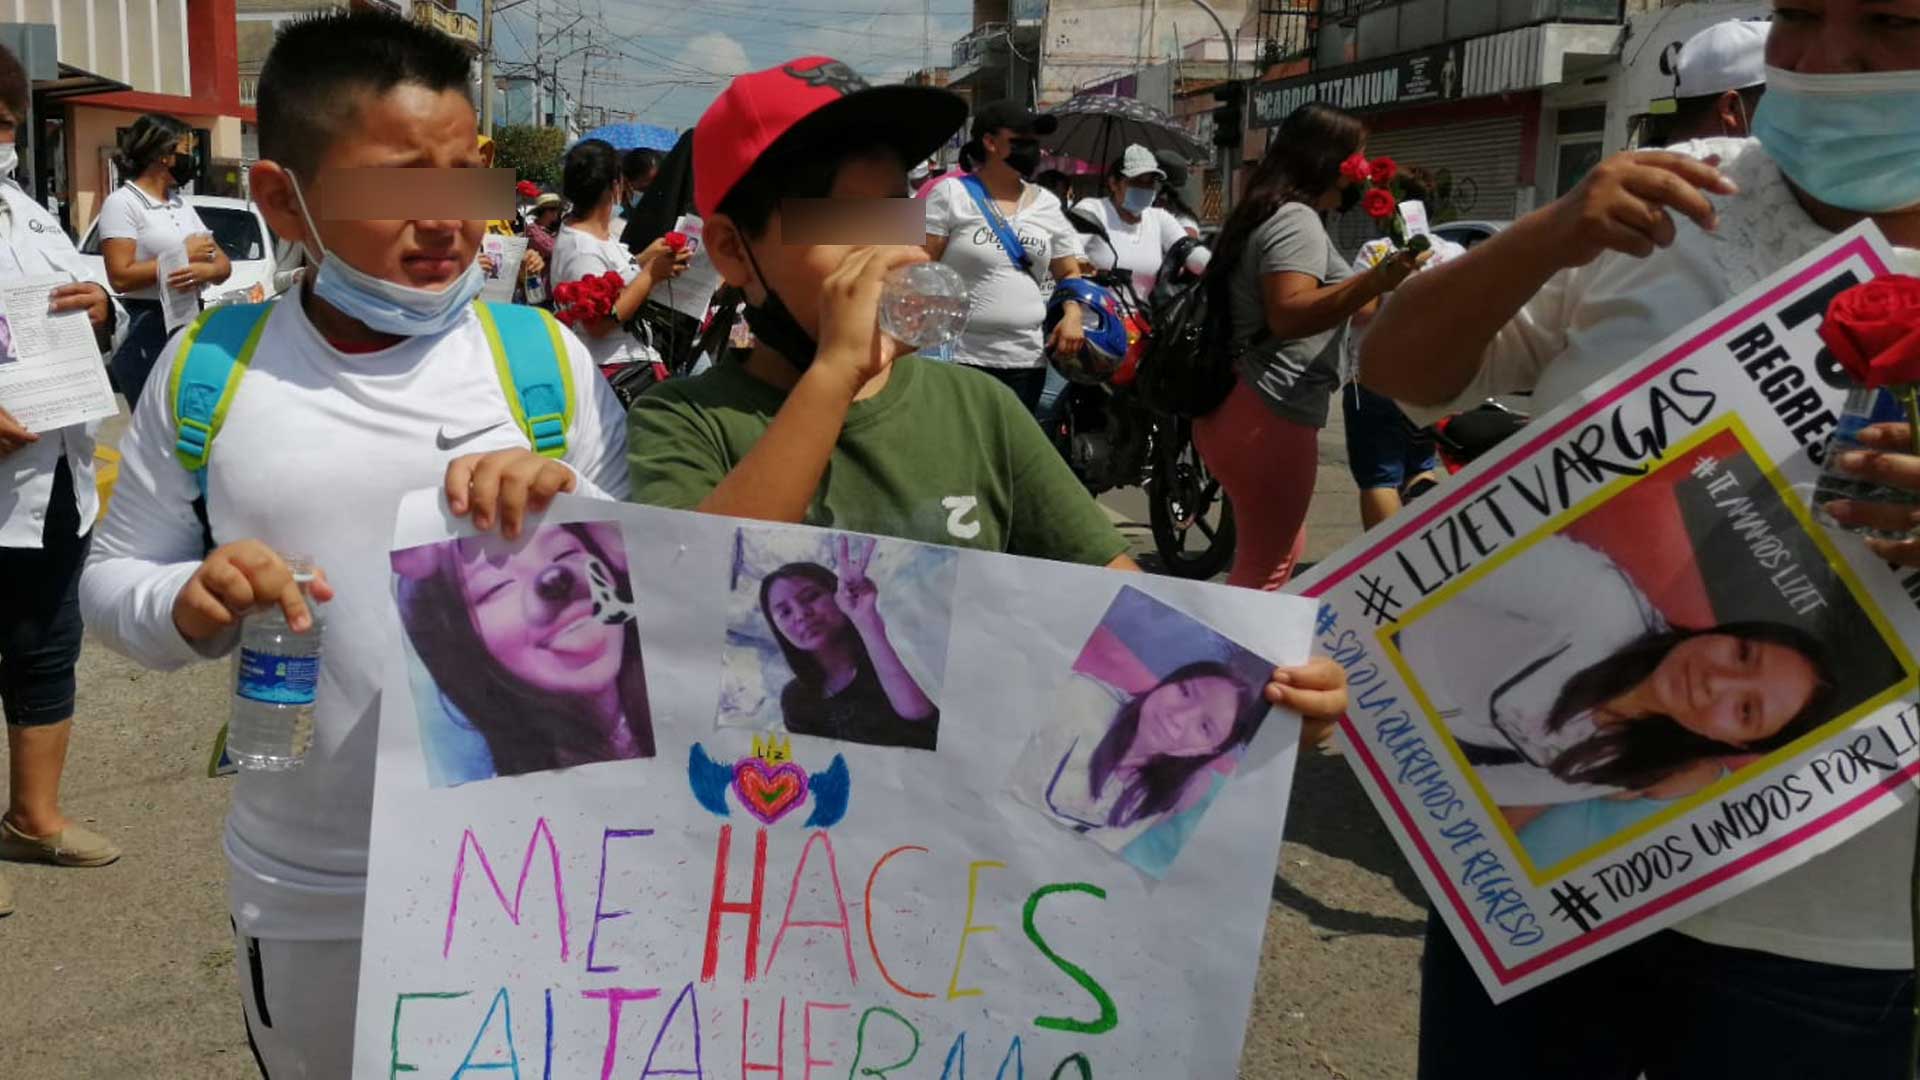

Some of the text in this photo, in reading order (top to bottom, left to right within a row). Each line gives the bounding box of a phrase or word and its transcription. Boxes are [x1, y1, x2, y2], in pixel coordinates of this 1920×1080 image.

[1264, 83, 1319, 121] CARDIO
[1319, 67, 1399, 109] TITANIUM
[1507, 367, 1717, 519] VARGAS
[1715, 496, 1792, 569] AMAMOS
[1771, 563, 1829, 615] LIZET
[1316, 603, 1546, 947] #SOLO LA QUEREMOS DE REGRESO
[1691, 773, 1813, 857] UNIDOS
[1810, 733, 1900, 795] POR
[443, 817, 1119, 1035] ME HACES
